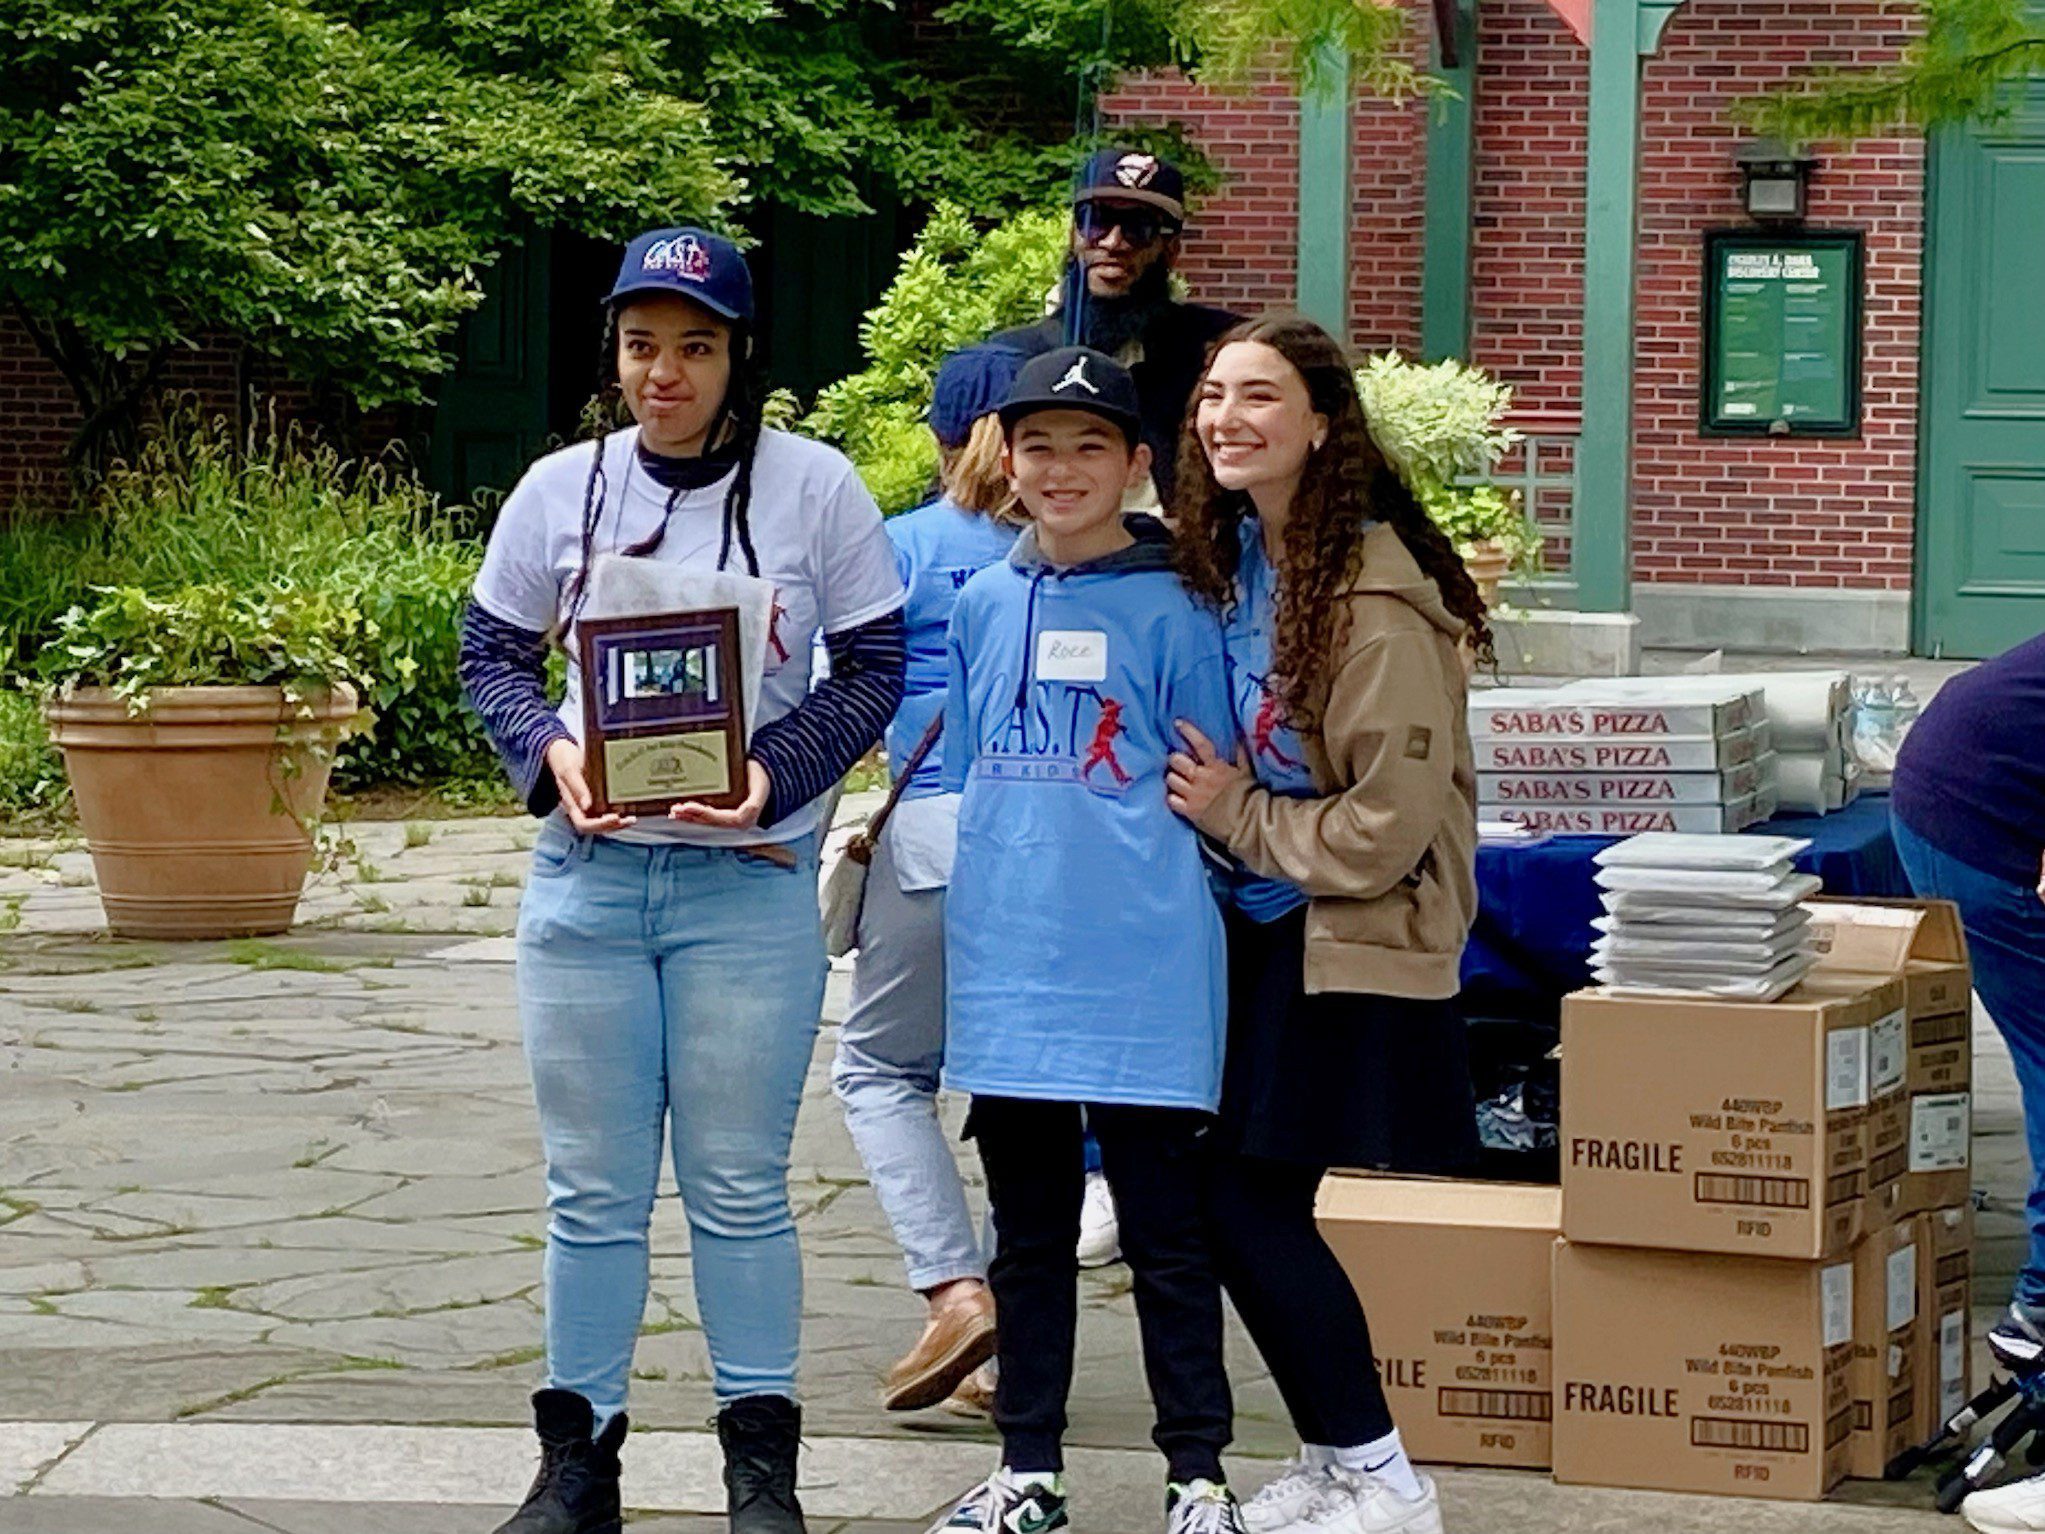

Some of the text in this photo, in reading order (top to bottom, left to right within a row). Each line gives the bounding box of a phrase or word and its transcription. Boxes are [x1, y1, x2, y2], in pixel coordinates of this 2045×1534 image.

[1490, 711, 1670, 734] SABA'S PIZZA
[1493, 746, 1672, 768] SABA'S PIZZA
[1497, 779, 1676, 799] SABA'S PIZZA
[1602, 811, 1677, 831] PIZZA
[1746, 1138, 1771, 1151] pcs
[1571, 1138, 1684, 1173] FRAGILE
[1564, 1381, 1680, 1418] FRAGILE
[1742, 1383, 1769, 1396] pcs
[1735, 1465, 1770, 1481] RFID
